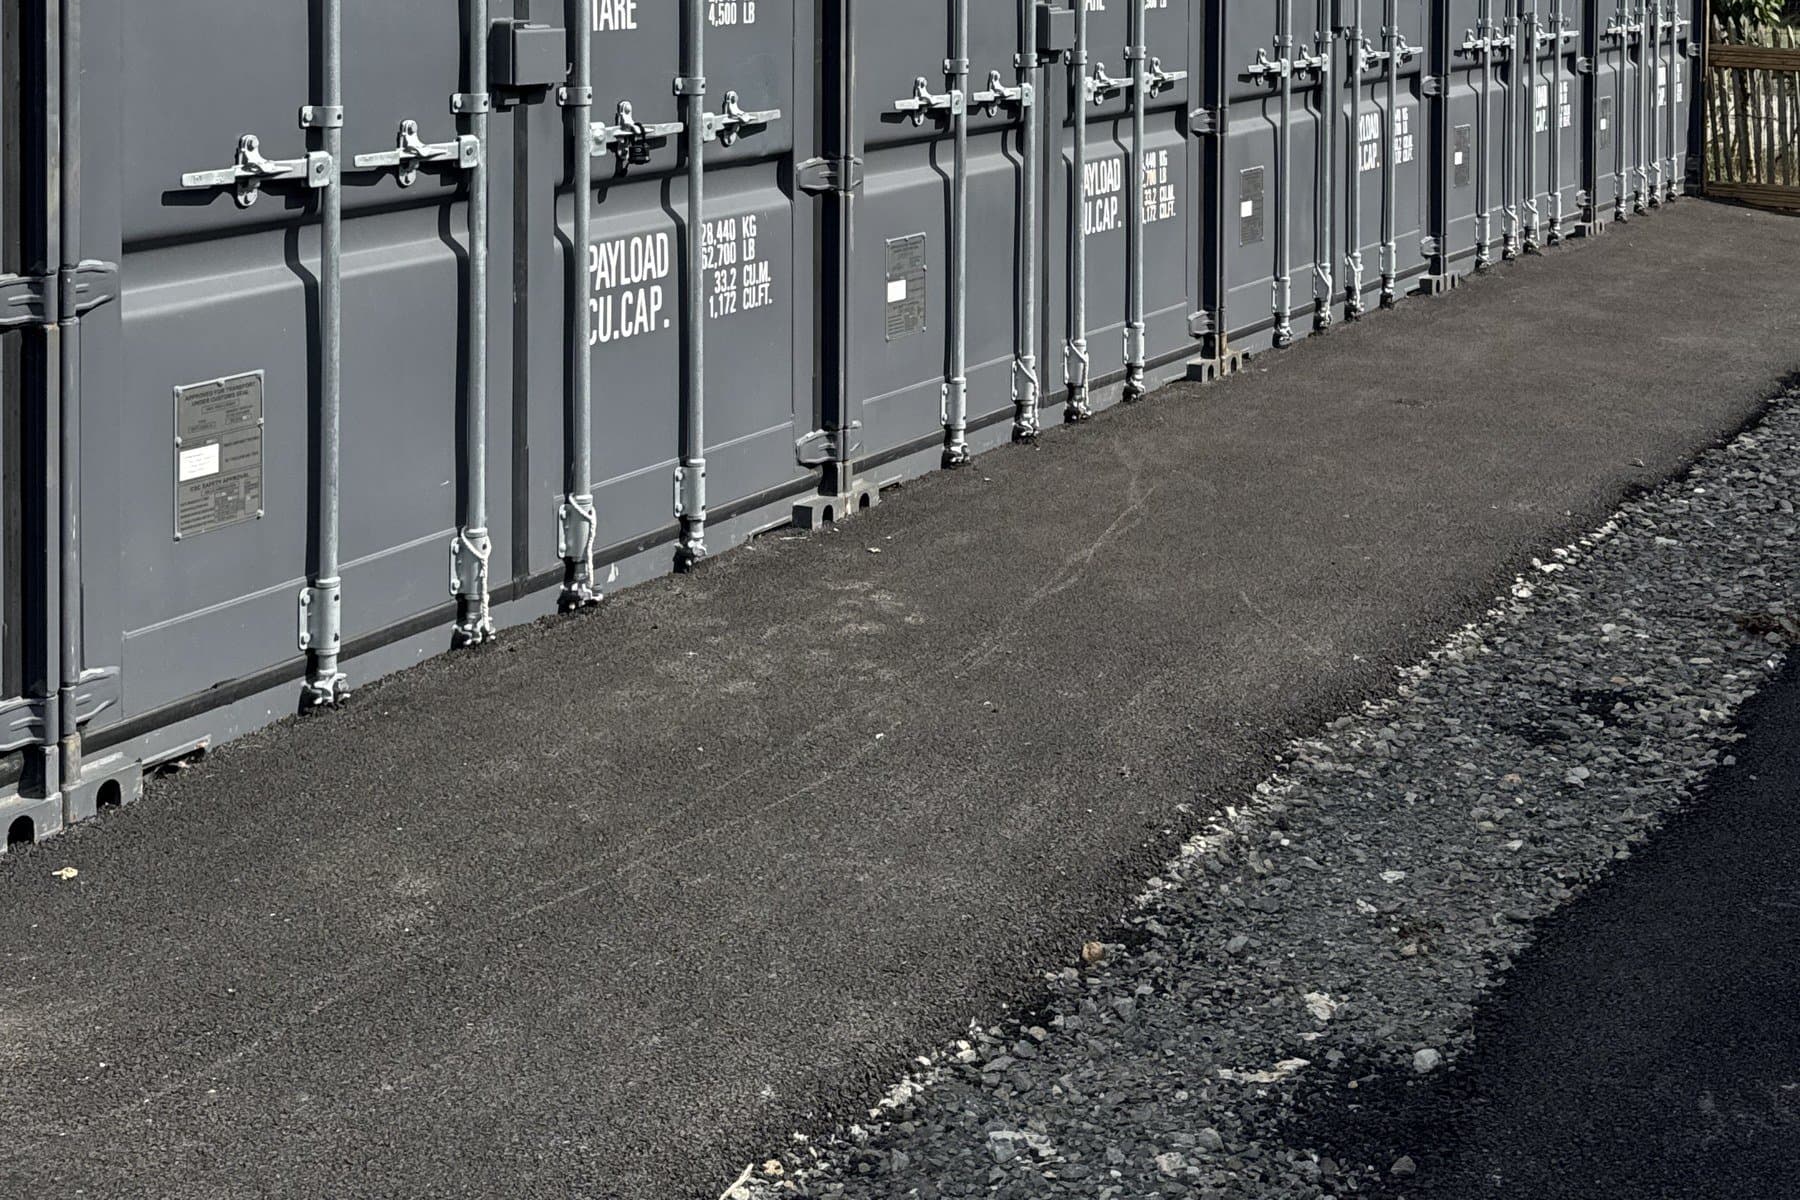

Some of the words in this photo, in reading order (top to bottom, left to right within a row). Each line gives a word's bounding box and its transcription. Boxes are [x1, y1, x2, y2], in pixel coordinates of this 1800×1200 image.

[708, 2, 737, 27] 4,500
[743, 2, 755, 24] LB
[1084, 158, 1121, 197] AYLOAD
[1084, 196, 1122, 235] U.CAP.
[589, 232, 669, 291] PAYLOAD
[702, 218, 736, 247] 28,440
[742, 214, 757, 237] KG
[702, 241, 736, 270] 62,700
[743, 238, 755, 261] LB
[714, 267, 737, 294] 33.2
[743, 260, 772, 286] CU.M.
[709, 291, 737, 319] 1,172
[743, 283, 773, 310] CU.FT.
